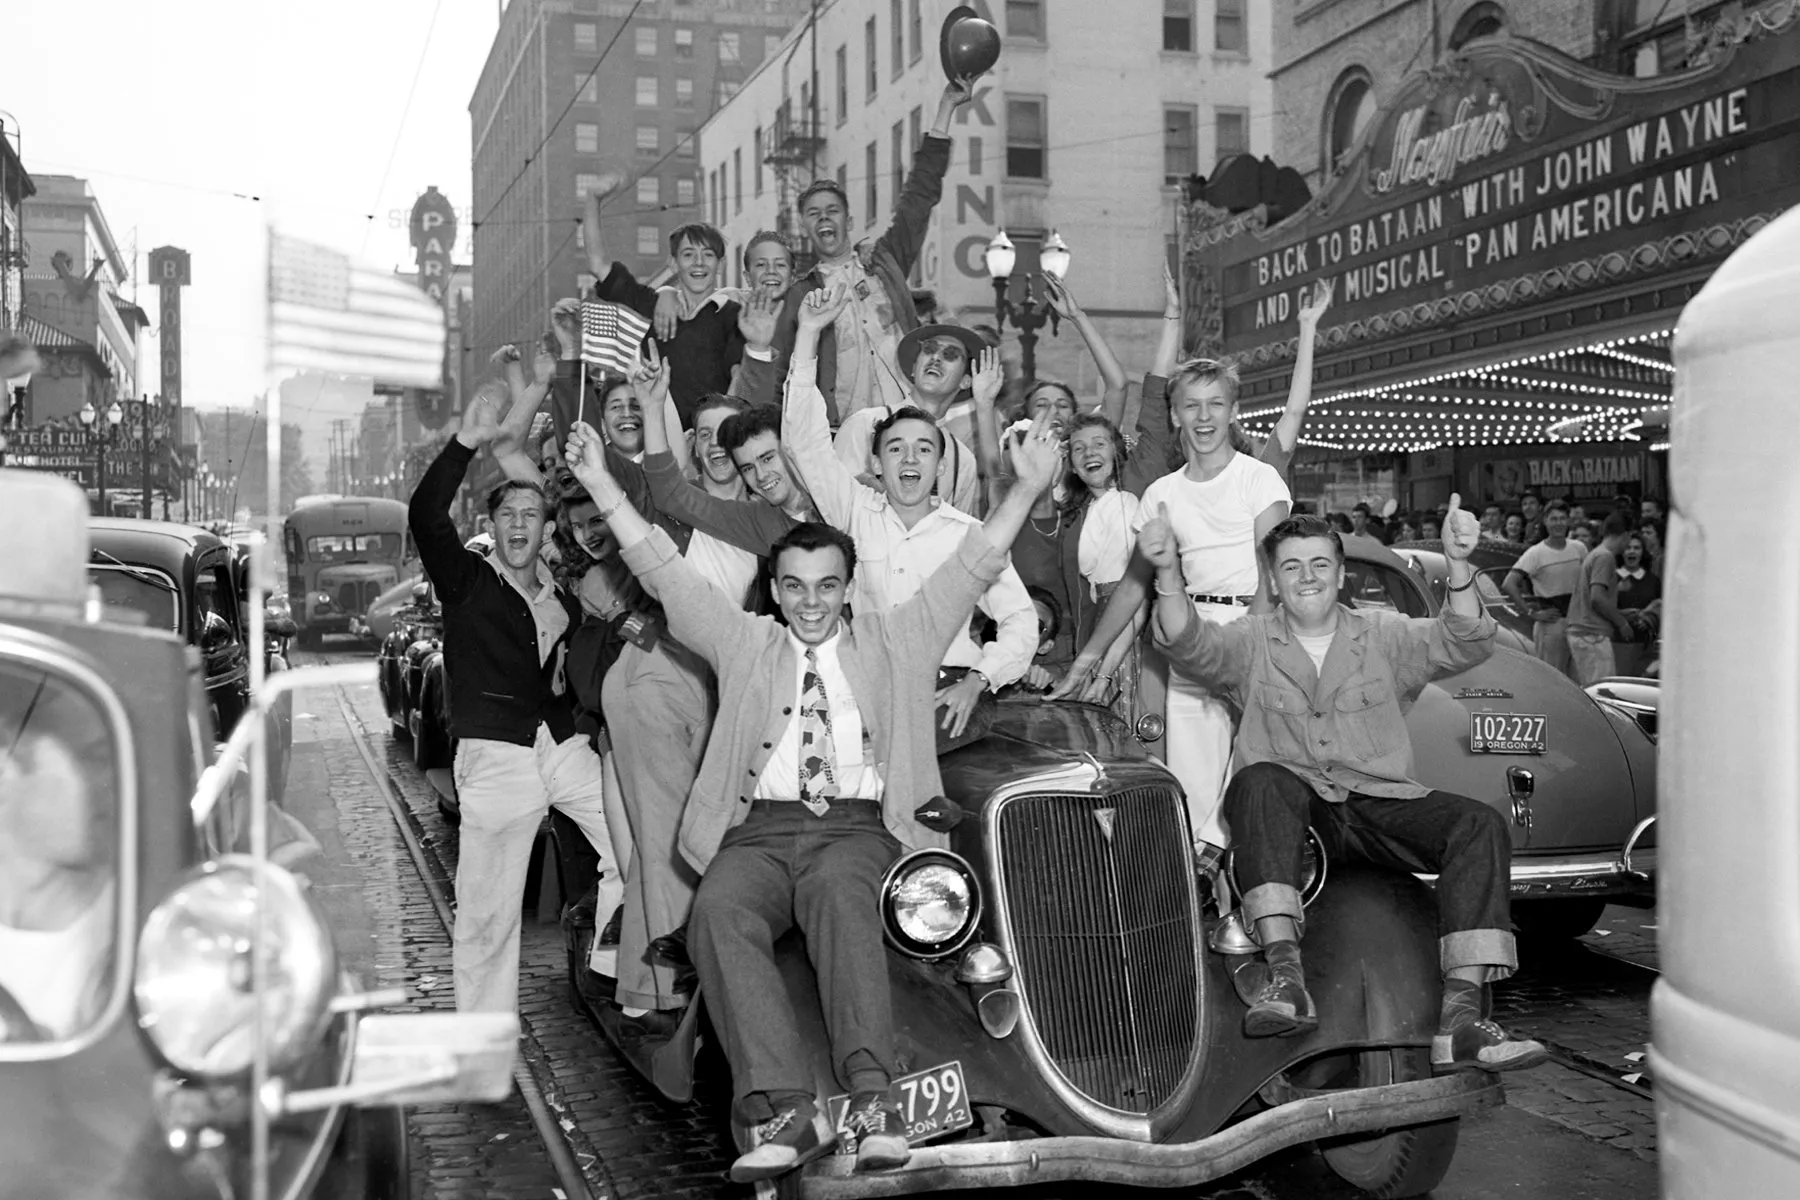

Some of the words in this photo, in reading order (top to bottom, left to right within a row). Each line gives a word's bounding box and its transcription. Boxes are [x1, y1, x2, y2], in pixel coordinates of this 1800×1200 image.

[953, 0, 998, 279] KING
[1317, 231, 1342, 267] TO
[1536, 136, 1612, 195] JOHN
[1626, 88, 1748, 166] WAYNE
[1255, 292, 1290, 329] AND
[1345, 245, 1445, 302] MUSICAL
[163, 260, 178, 401] BROADW
[18, 432, 52, 445] TEA
[41, 456, 80, 466] HOTEL
[108, 461, 133, 475] THE
[1528, 459, 1572, 486] BACK
[1572, 465, 1583, 484] to
[1583, 455, 1640, 484] BATAAN
[1474, 740, 1483, 749] 19
[1487, 741, 1528, 749] OREGON
[1531, 742, 1544, 750] 42
[944, 1109, 966, 1124] 42
